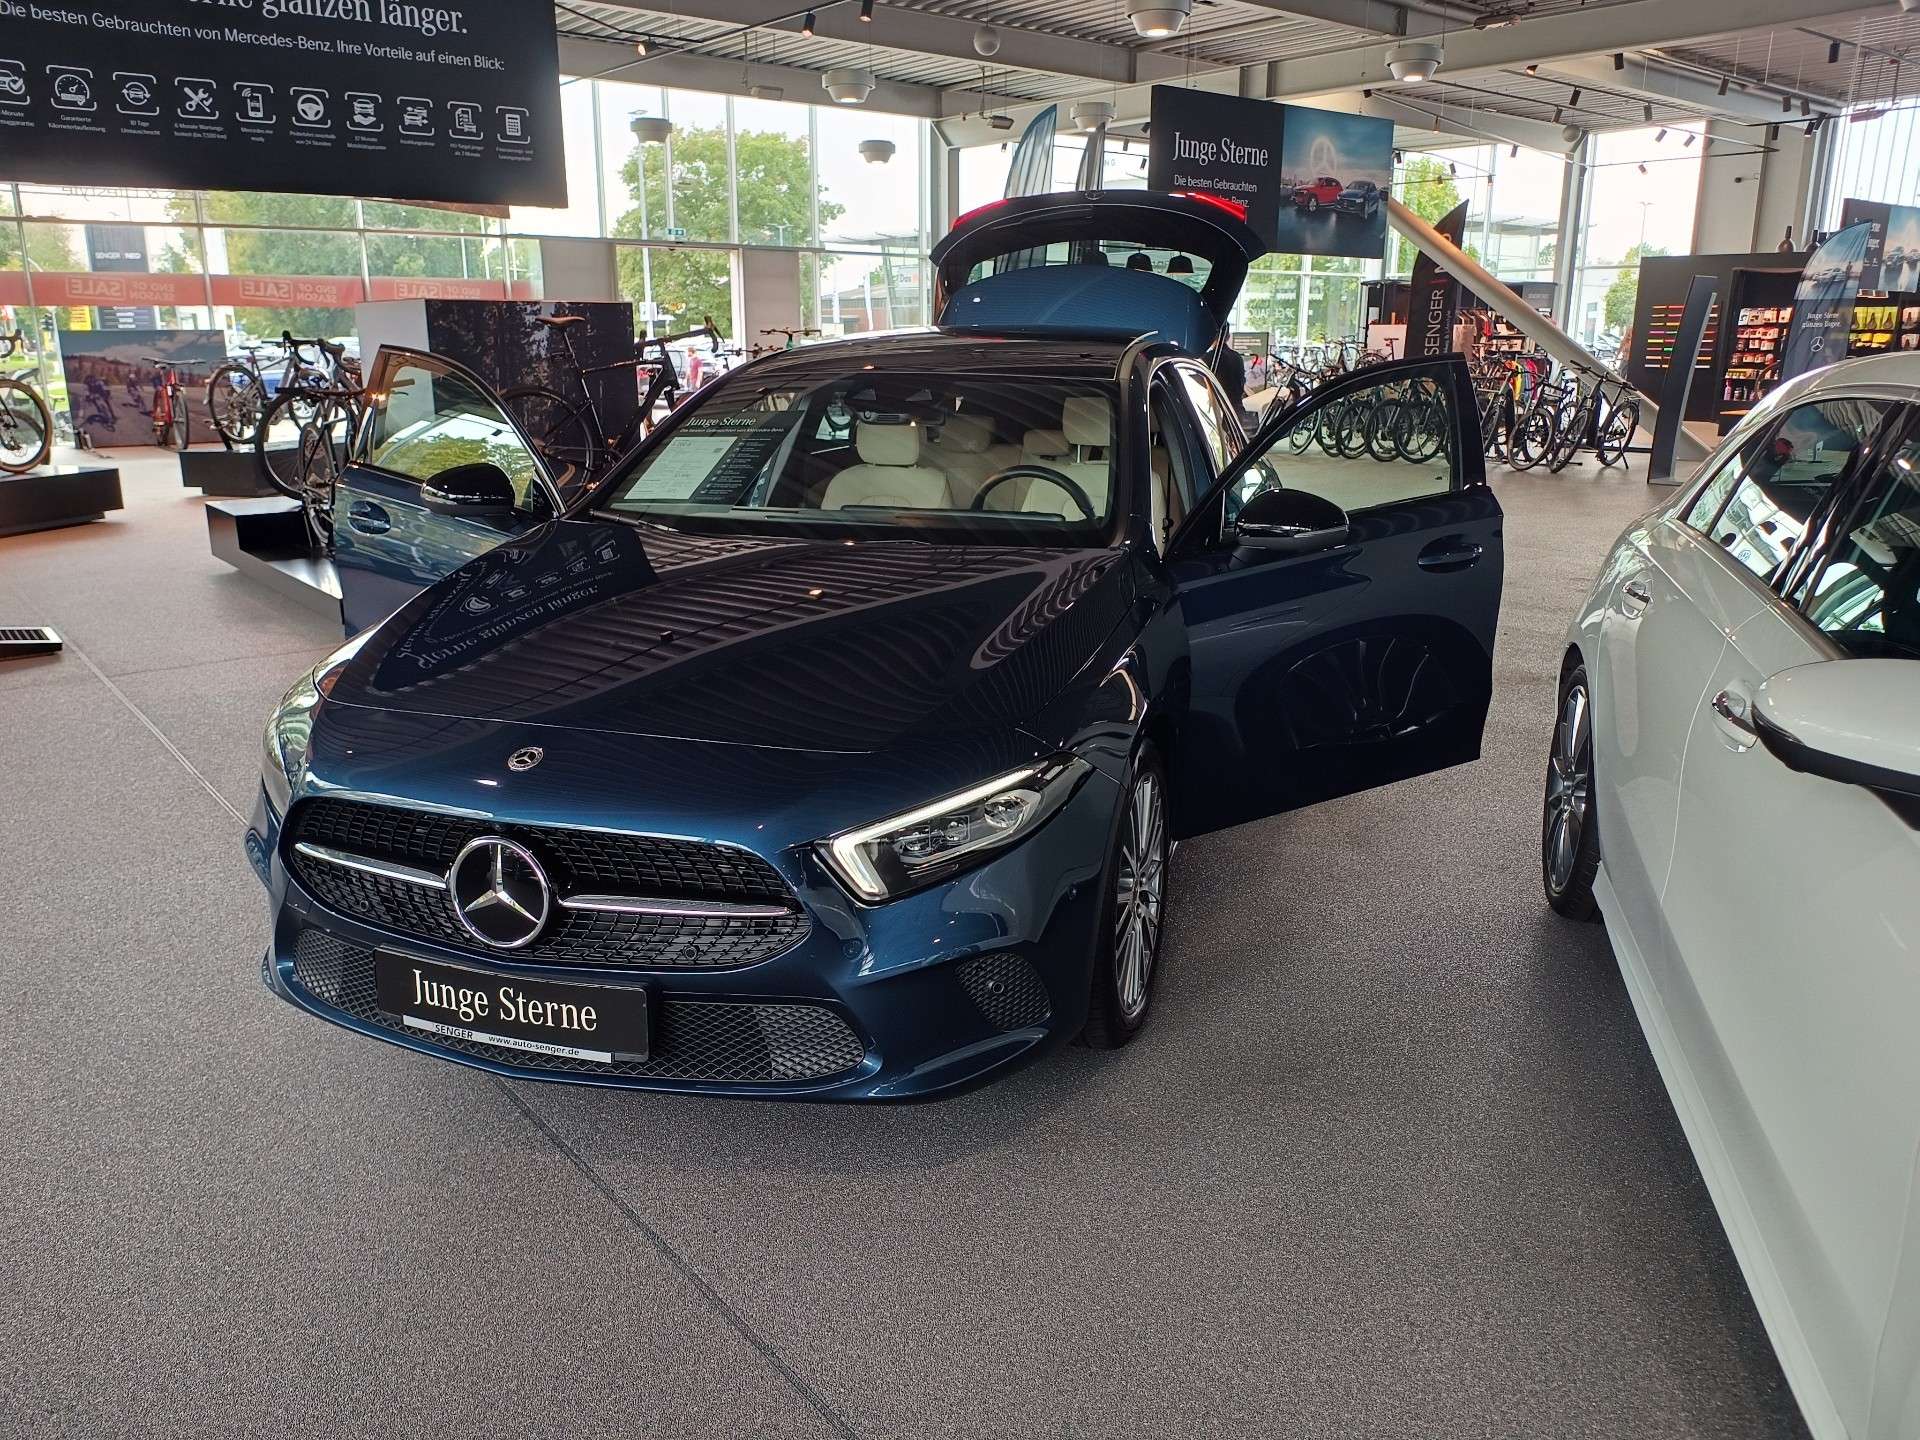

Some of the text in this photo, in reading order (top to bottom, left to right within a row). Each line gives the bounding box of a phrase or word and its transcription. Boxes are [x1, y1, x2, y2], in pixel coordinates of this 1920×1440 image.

[0, 0, 505, 71] Die besten Gebrauchten von Mercedes-Benz. Ihre Vorteile auf einen Blick:
[380, 0, 468, 36] länger.
[1172, 131, 1268, 167] Junge Sterne
[1174, 174, 1258, 192] Die besten Gebrauchten
[1424, 289, 1445, 356] SENGER
[686, 416, 757, 428] Junge Sterne
[412, 968, 597, 1031] Junge Sterne
[435, 1024, 580, 1056] SENGER www.auto-senger.de
